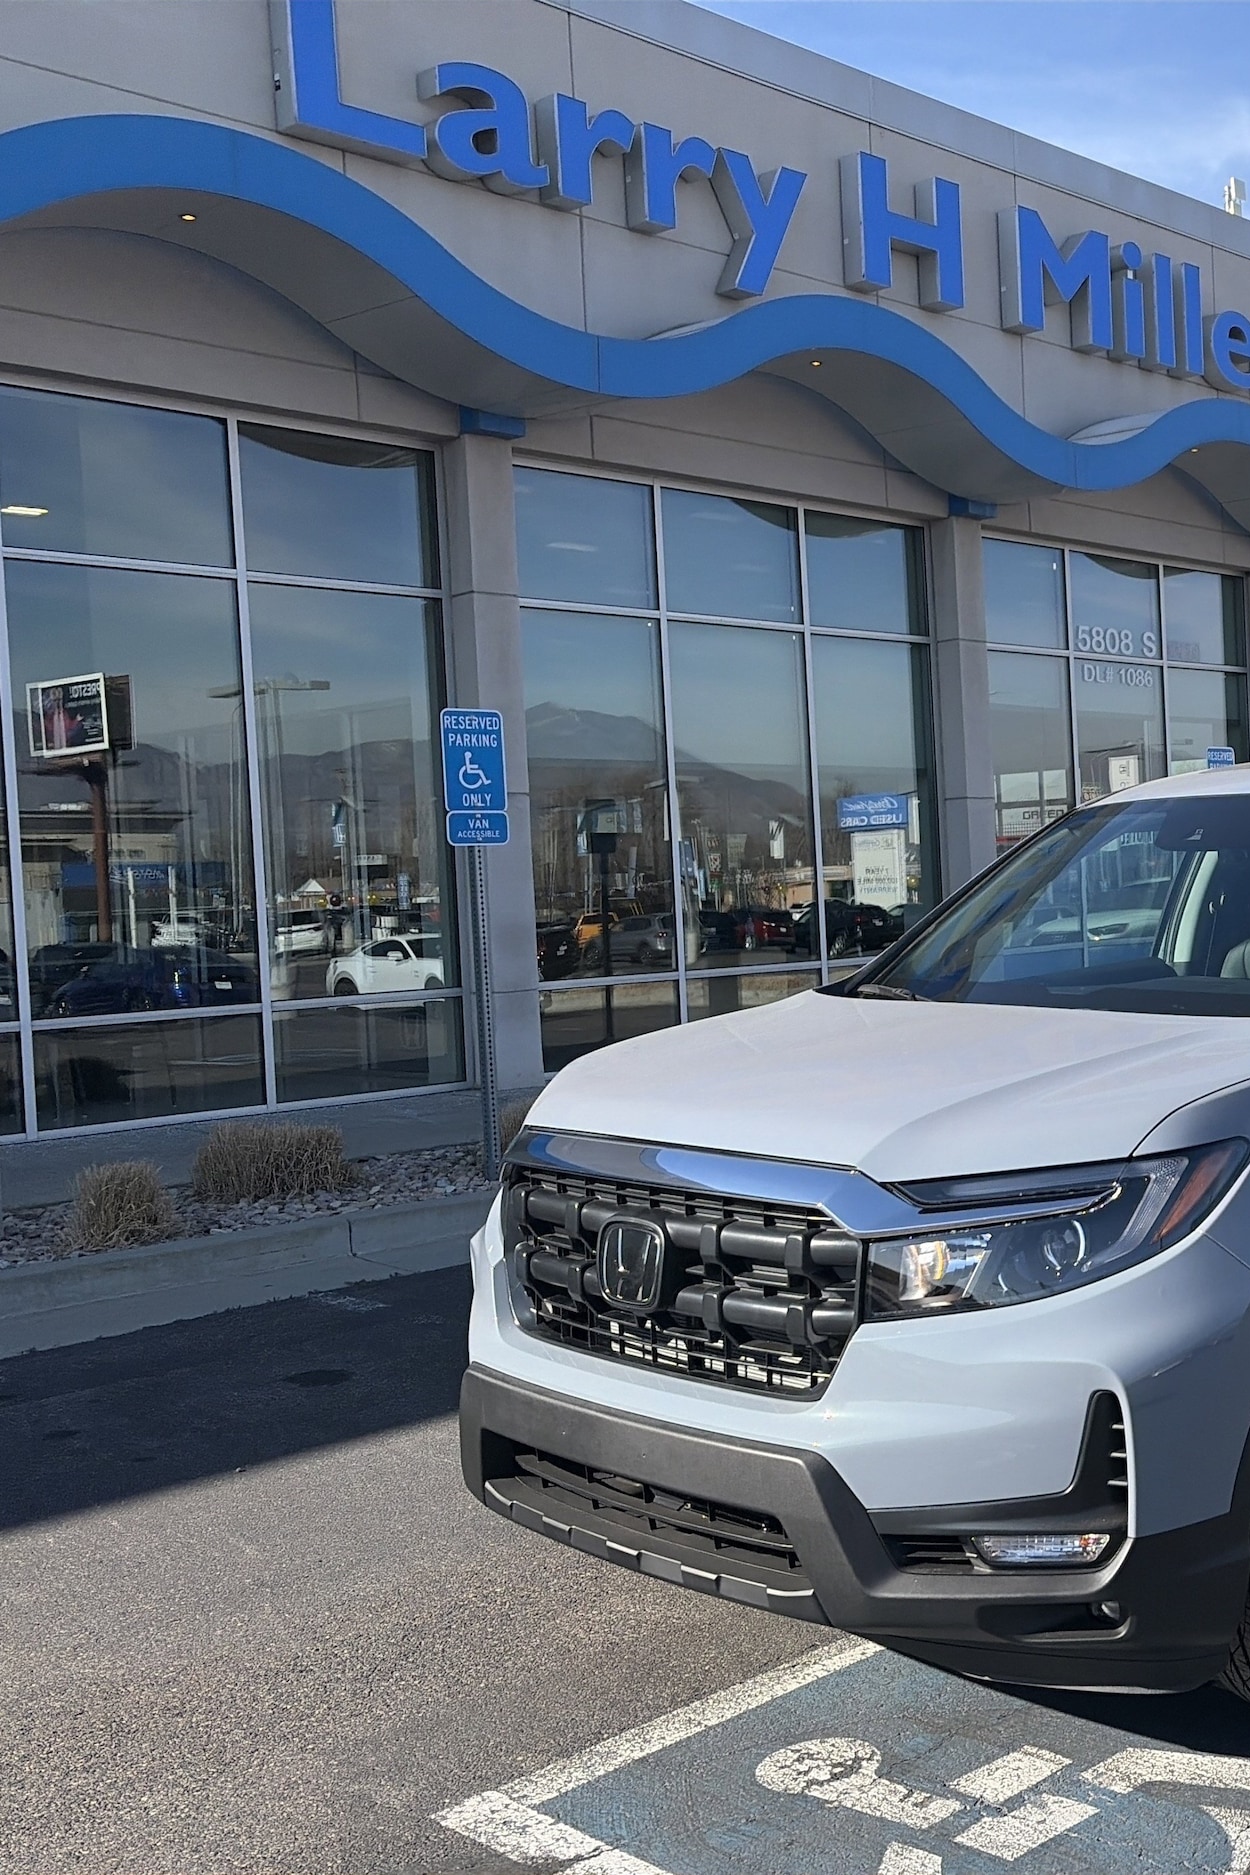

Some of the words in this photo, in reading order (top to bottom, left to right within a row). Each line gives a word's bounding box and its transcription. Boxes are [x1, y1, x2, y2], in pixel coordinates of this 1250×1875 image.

[273, 0, 806, 298] Larry
[840, 151, 964, 312] H
[1077, 625, 1133, 655] 5808
[1142, 631, 1157, 658] S
[1083, 663, 1114, 683] DL#
[1119, 668, 1153, 687] 1086
[444, 715, 499, 730] RESERVED
[448, 733, 498, 747] PARKING
[1208, 751, 1233, 761] RESERVED
[462, 793, 492, 807] ONLY
[468, 818, 490, 829] VAN
[457, 830, 500, 838] ACCESSIBLE
